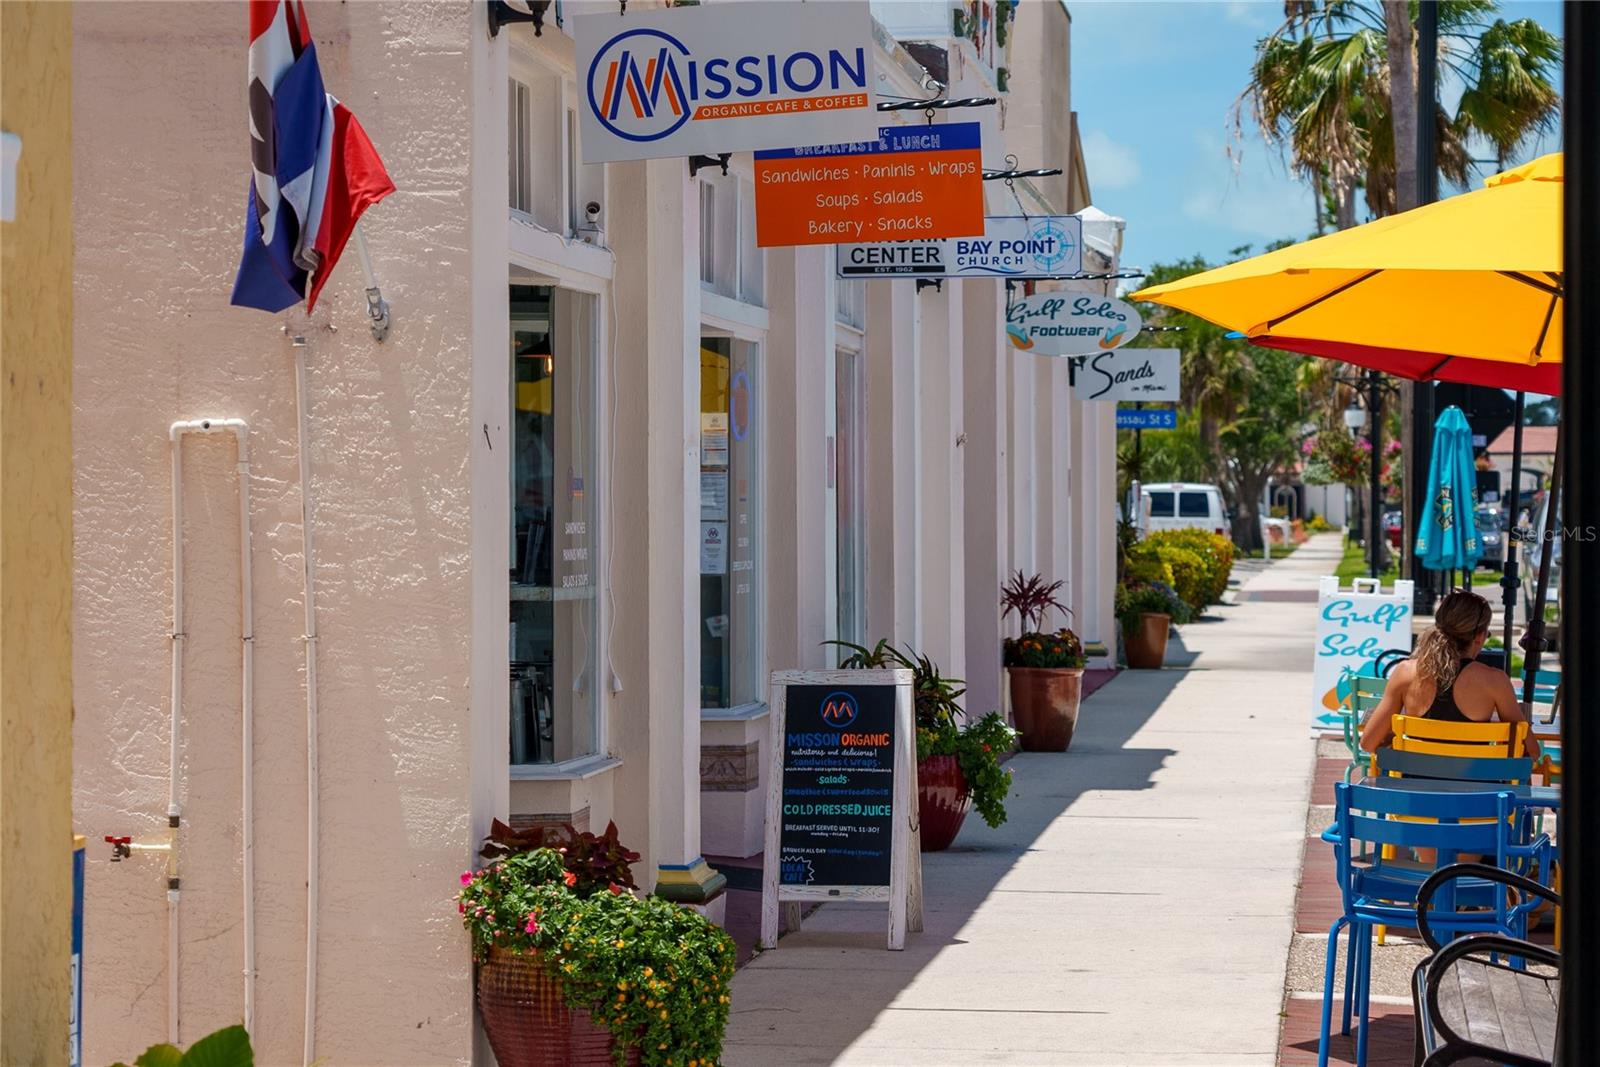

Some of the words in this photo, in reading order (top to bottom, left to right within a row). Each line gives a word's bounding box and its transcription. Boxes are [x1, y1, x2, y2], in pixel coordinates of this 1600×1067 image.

[601, 47, 867, 121] MISSION
[701, 103, 762, 118] ORGANIC
[766, 100, 799, 112] CAFE
[803, 99, 811, 109] &
[815, 95, 864, 108] COFFEE
[893, 134, 941, 151] LUNCH
[761, 167, 850, 184] Sandwiches
[863, 163, 916, 179] Paninis
[928, 160, 977, 178] Wraps
[816, 192, 860, 211] Soups
[873, 189, 924, 205] Salads
[808, 219, 864, 237] Bakery
[877, 216, 933, 231] Snacks
[851, 246, 940, 264] CENTER
[957, 240, 993, 255] BAY
[957, 256, 1024, 266] CHURCH
[1006, 299, 1065, 323] Gulf
[1071, 297, 1127, 322] Soles
[1030, 325, 1104, 337] Footwear
[1089, 351, 1155, 400] Sands
[1117, 414, 1146, 425] assau
[1149, 414, 1160, 425] St
[1163, 413, 1172, 425] S
[1322, 600, 1409, 632] Gulf
[788, 733, 839, 747] MISSON
[841, 732, 890, 746] ORGANIC
[783, 804, 814, 815] COLD
[815, 803, 861, 815] PRESSED
[862, 804, 891, 816] JUICE
[784, 824, 816, 832] BREAKFAST
[816, 824, 838, 832] SERVED
